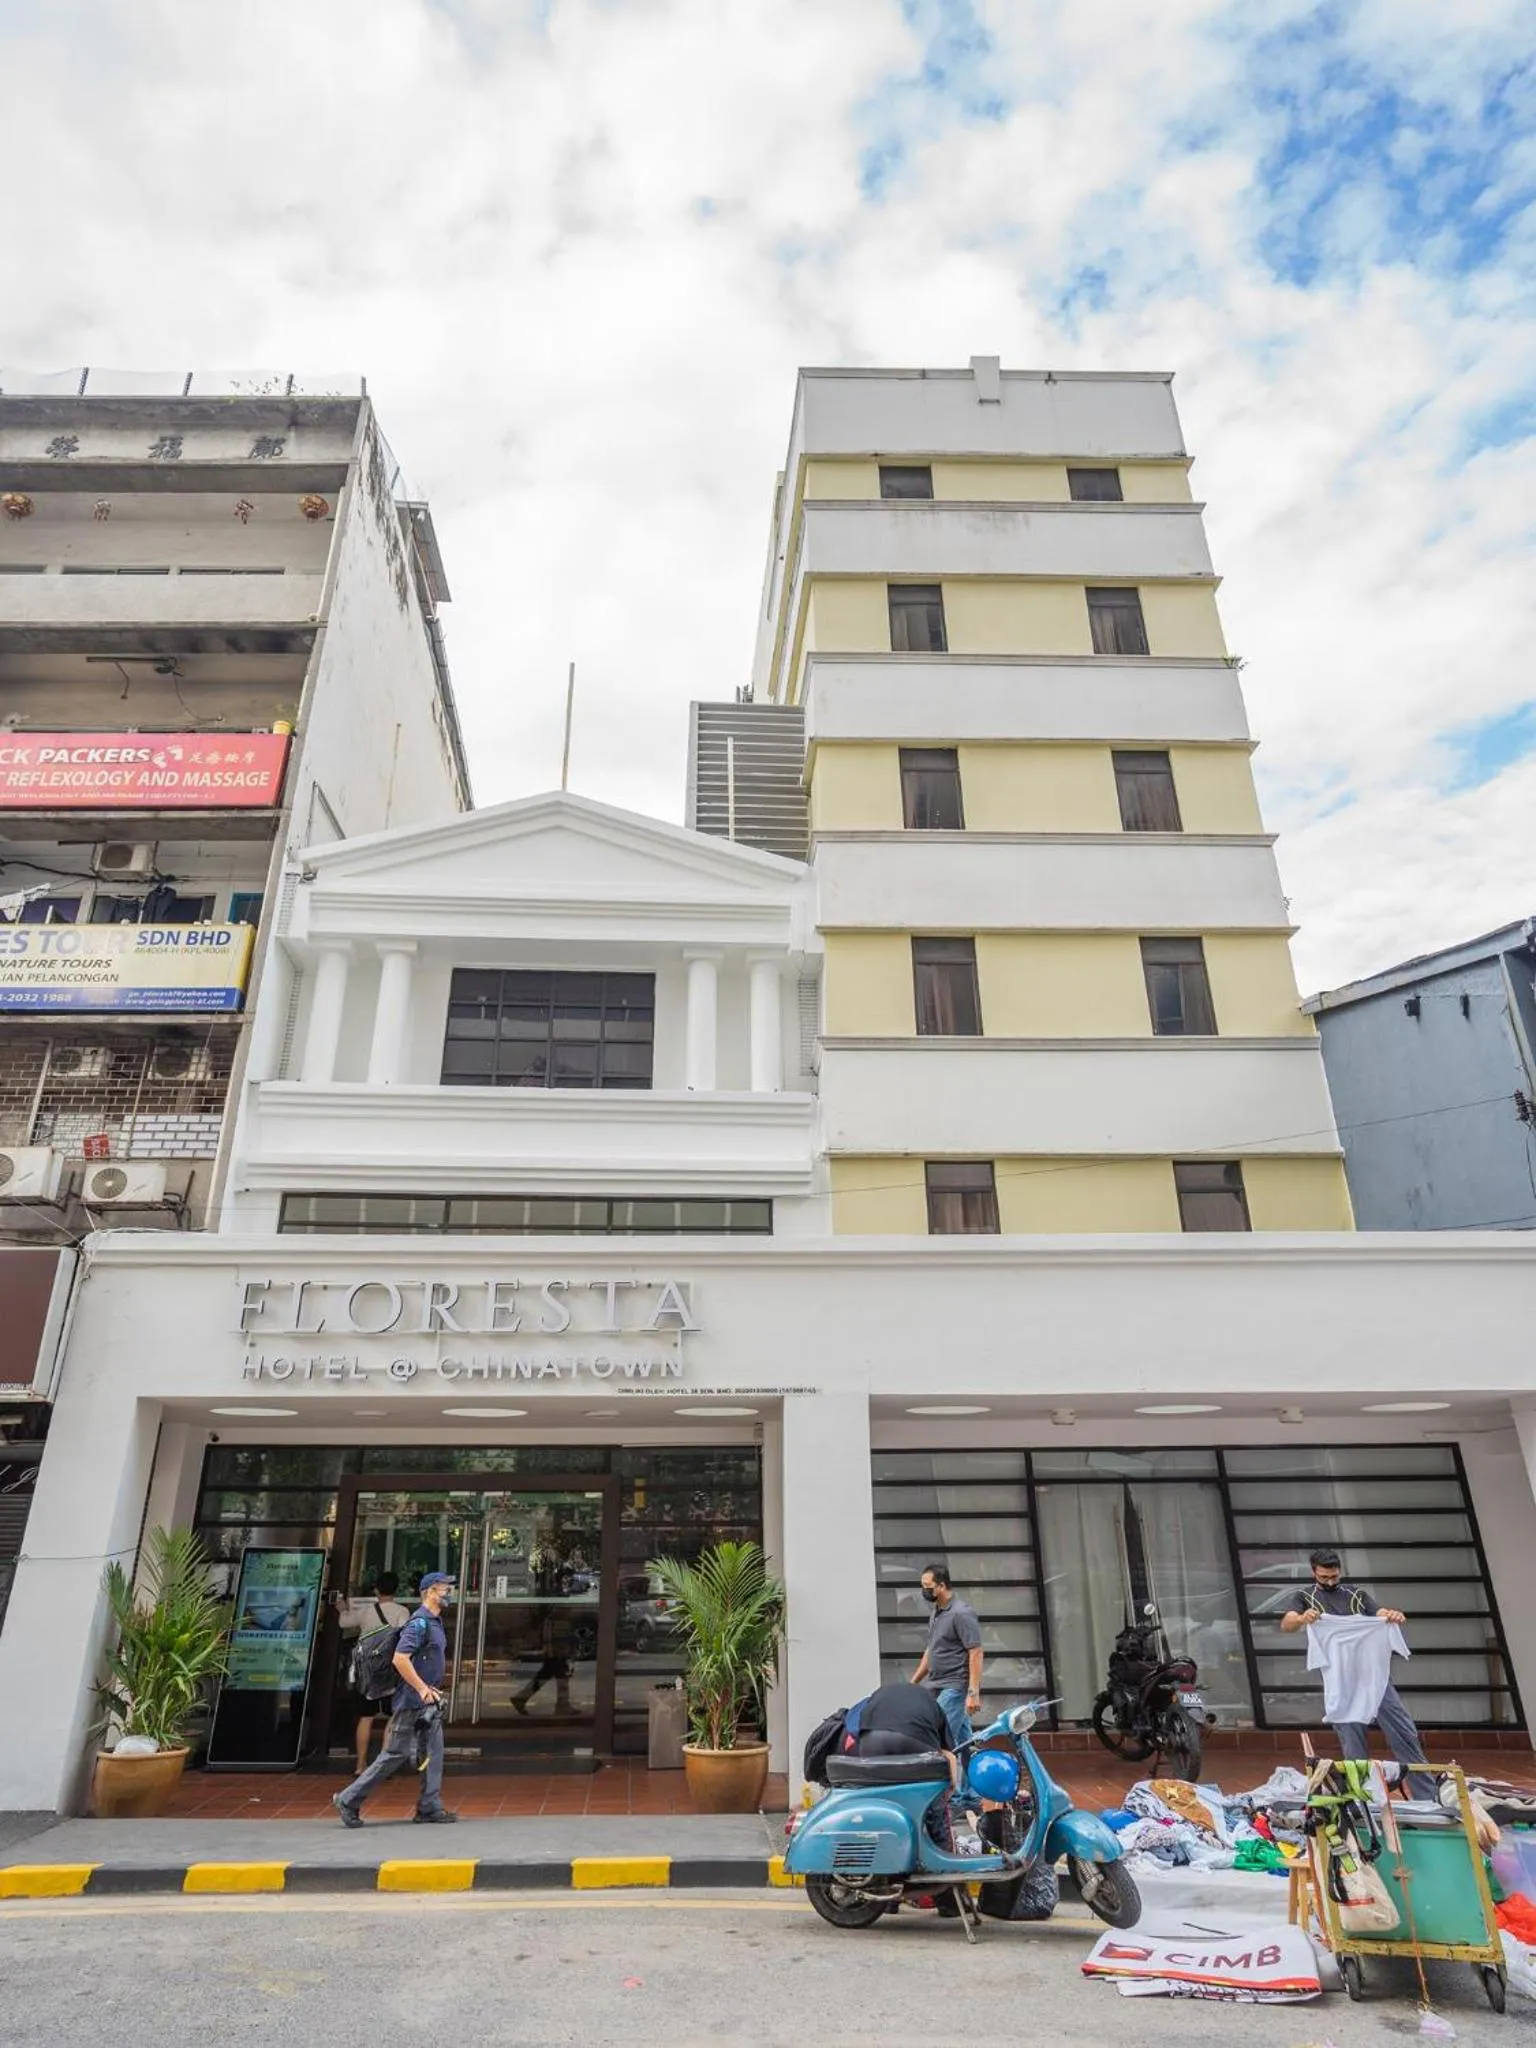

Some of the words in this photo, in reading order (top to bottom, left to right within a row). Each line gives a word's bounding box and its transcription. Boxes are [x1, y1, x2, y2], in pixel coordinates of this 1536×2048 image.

[36, 748, 154, 764] PACKERS
[6, 771, 136, 787] REFLEXOLOGY
[137, 771, 179, 786] AND
[182, 771, 270, 787] MASSAGE
[136, 930, 181, 946] SDN
[186, 930, 231, 946] BHD
[0, 959, 57, 968] NATURE
[61, 959, 112, 968] TOURS
[27, 973, 119, 982] PELANCONGAN
[237, 1279, 702, 1334] FLORESTA
[240, 1354, 368, 1380] HOTEL
[387, 1358, 418, 1382] @
[436, 1353, 683, 1379] CHINATOWN
[1164, 1944, 1282, 1970] CIMB
